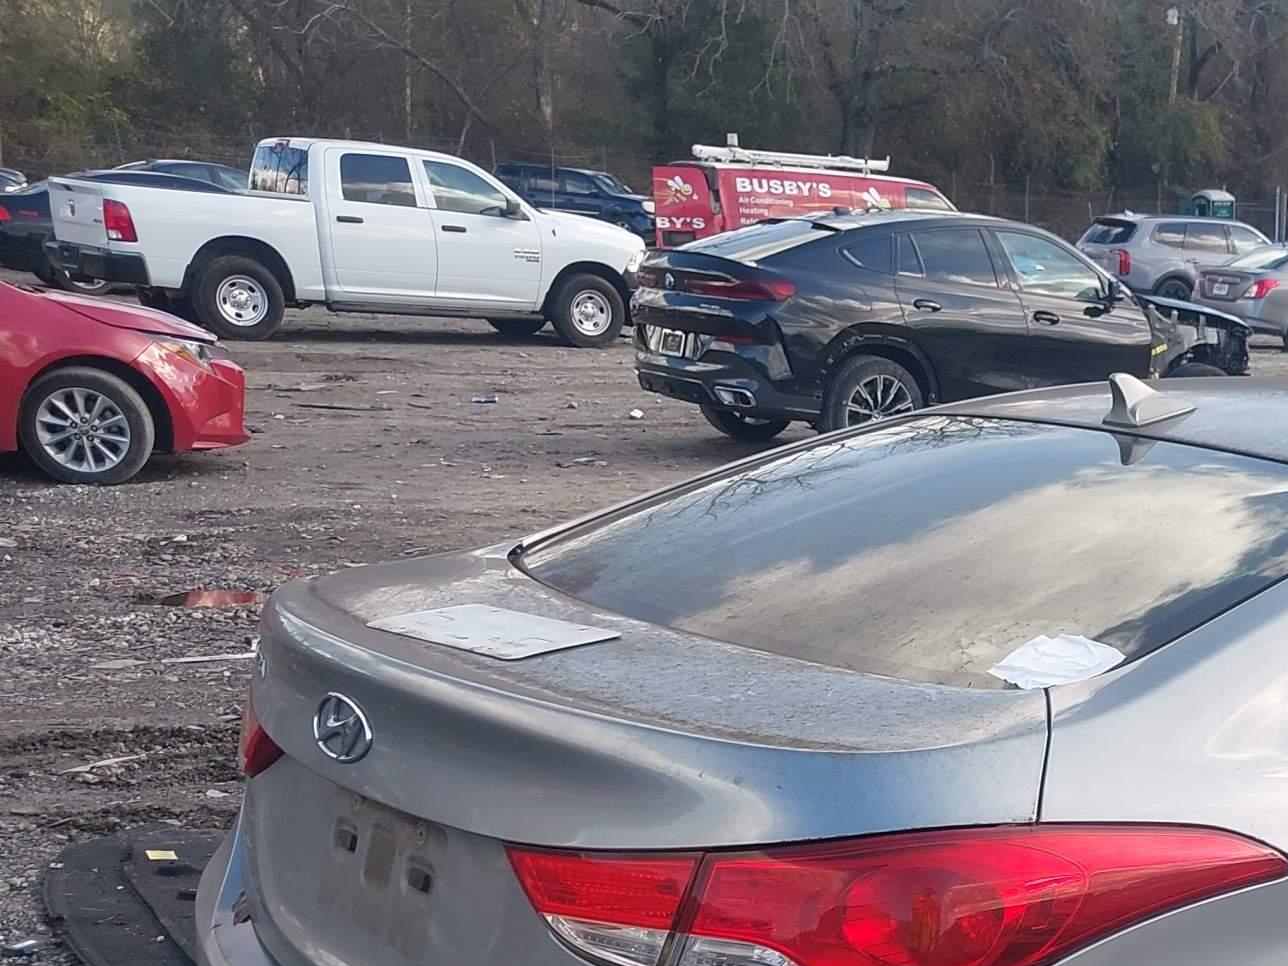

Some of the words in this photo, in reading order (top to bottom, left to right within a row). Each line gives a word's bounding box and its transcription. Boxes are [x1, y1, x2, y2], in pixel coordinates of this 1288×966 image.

[736, 177, 832, 198] BUSBY'S
[738, 196, 749, 204] Air
[750, 197, 794, 208] Conditioning
[739, 207, 769, 216] Heating
[655, 216, 706, 229] BY'S
